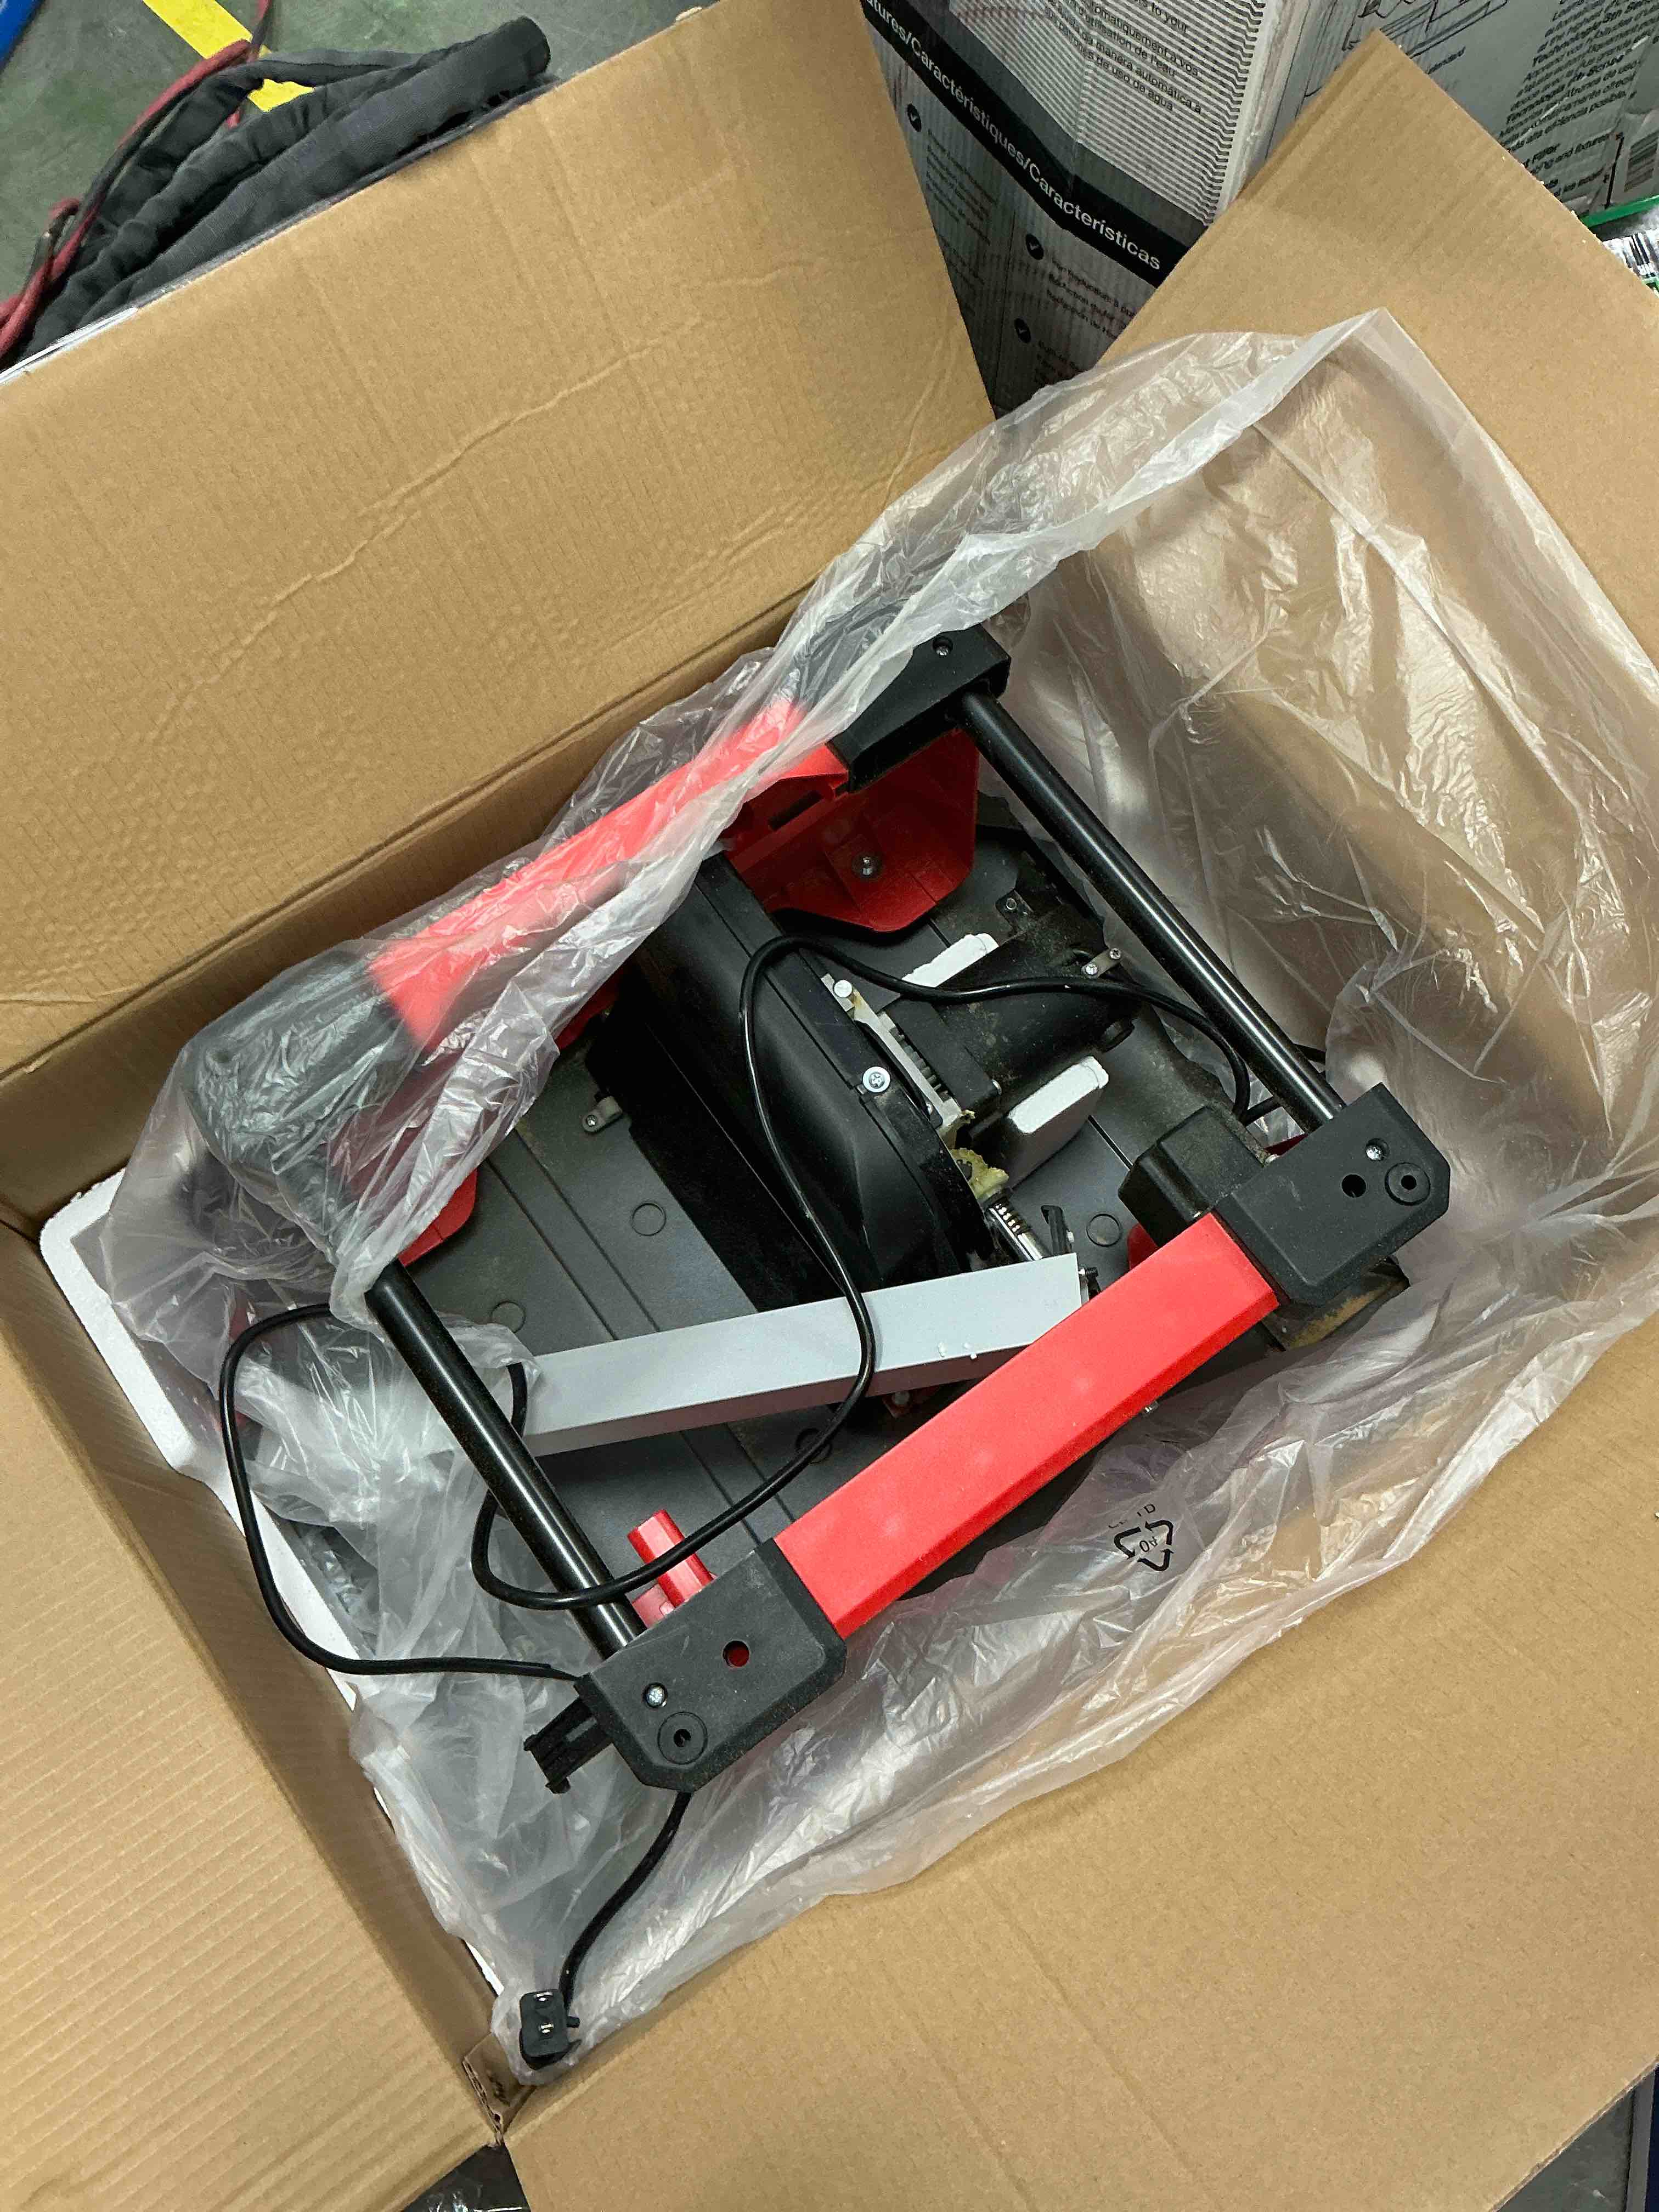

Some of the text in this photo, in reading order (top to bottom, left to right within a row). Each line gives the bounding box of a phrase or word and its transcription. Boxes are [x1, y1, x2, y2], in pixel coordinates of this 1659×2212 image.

[1164, 12, 1187, 33] your
[1096, 41, 1133, 72] manera
[1135, 47, 1148, 59] de
[1112, 66, 1130, 83] uso
[1133, 78, 1146, 93] de
[1148, 89, 1173, 111] agua
